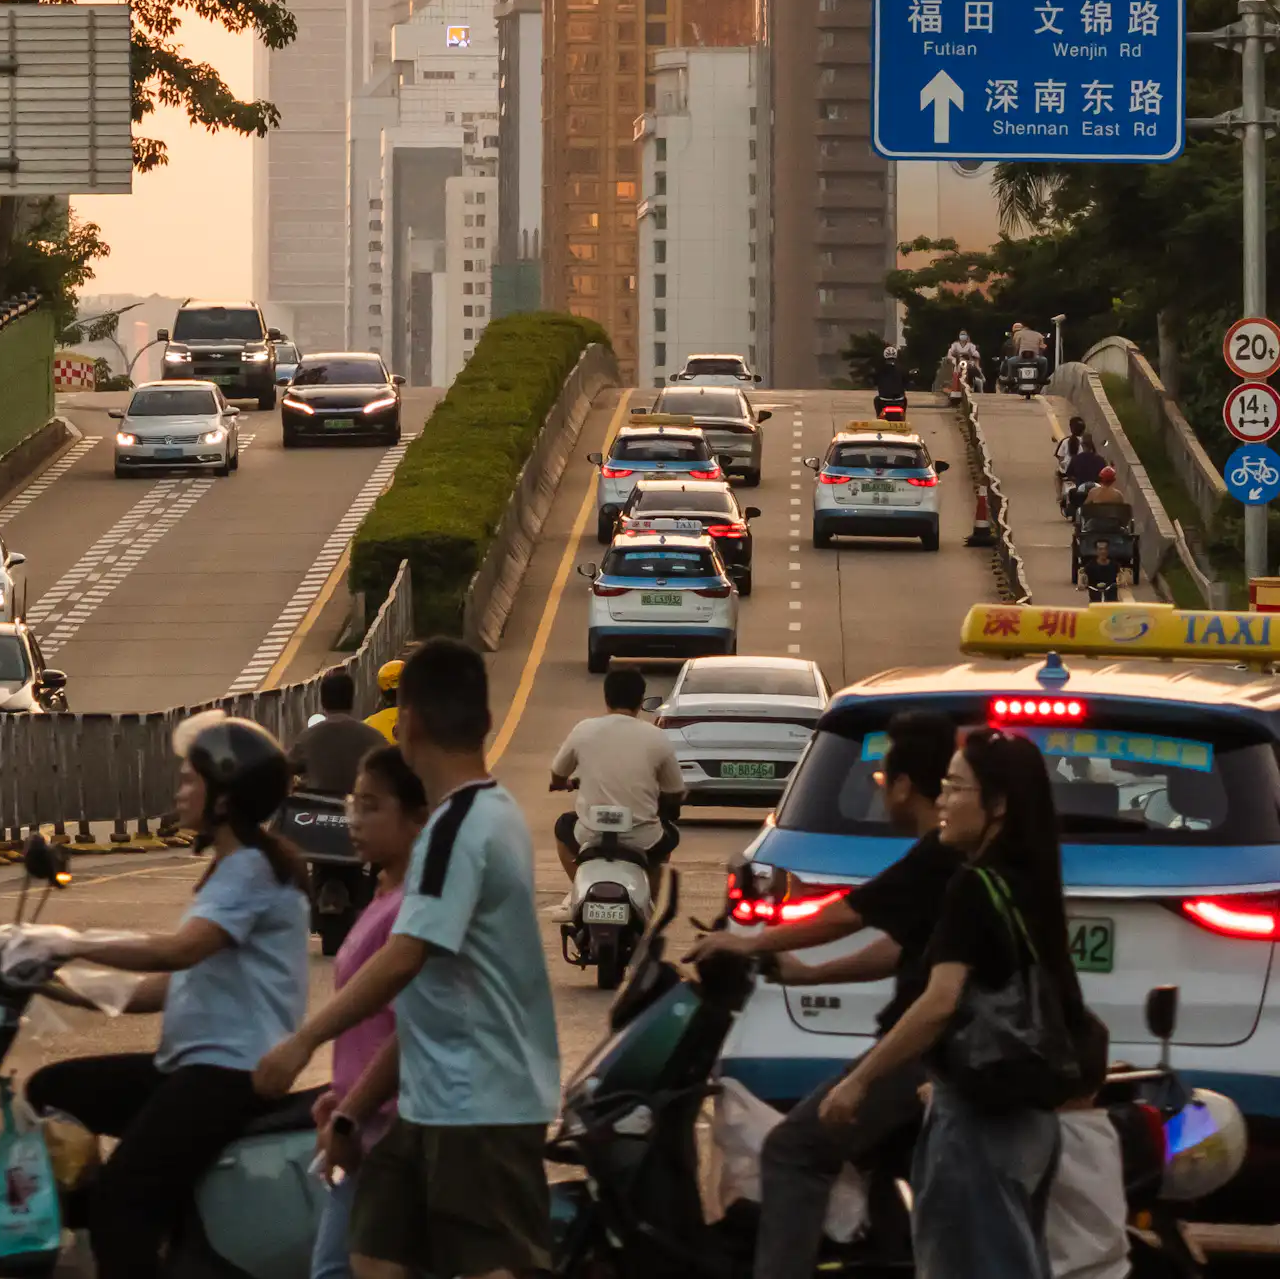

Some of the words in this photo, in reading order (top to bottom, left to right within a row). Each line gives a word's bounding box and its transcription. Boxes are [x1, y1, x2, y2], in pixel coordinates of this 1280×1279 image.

[907, 0, 994, 34] 福田
[1034, 0, 1160, 37] 文锦路
[923, 41, 977, 57] Futian
[1053, 42, 1108, 61] Wenjin
[1120, 43, 1142, 58] Rd
[984, 79, 1163, 115] 深南东路
[993, 120, 1069, 136] Shennan
[1082, 122, 1120, 137] East
[1134, 122, 1157, 137] Rd
[675, 521, 697, 529] TAXI
[982, 609, 1078, 639] 深圳
[1180, 614, 1273, 646] TAXI
